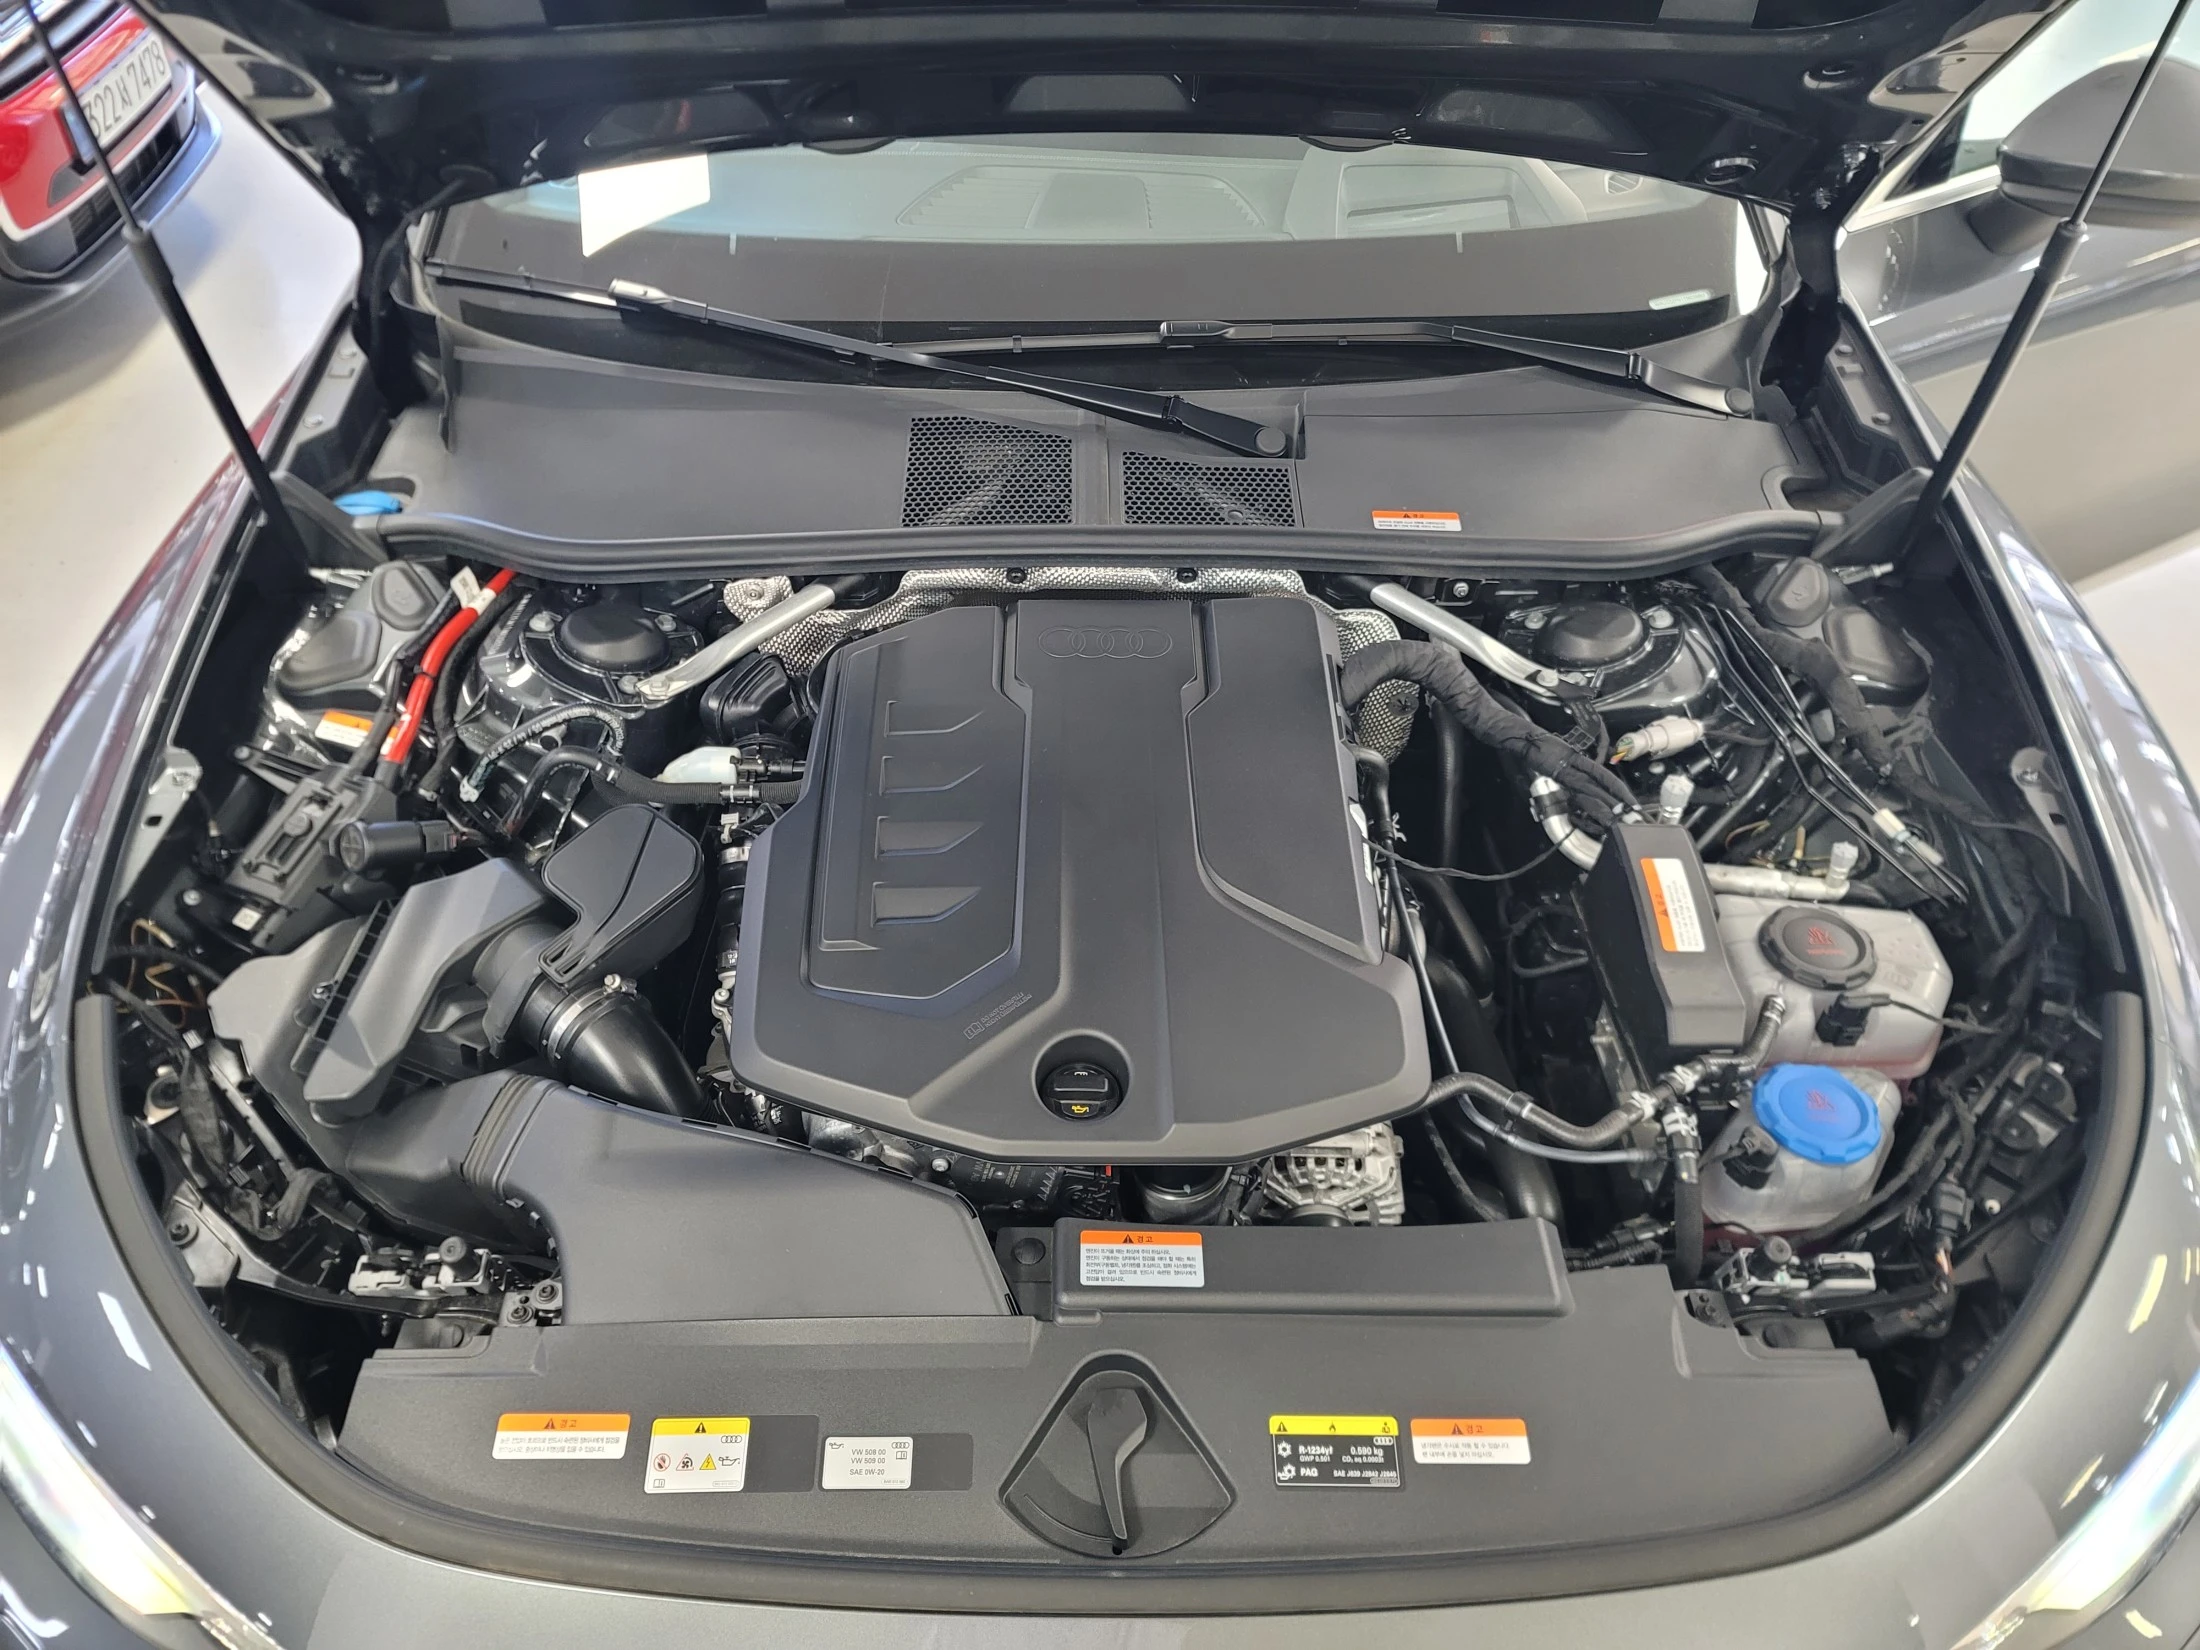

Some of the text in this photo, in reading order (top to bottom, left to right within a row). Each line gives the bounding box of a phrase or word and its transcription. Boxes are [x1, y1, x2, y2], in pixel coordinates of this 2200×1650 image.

[849, 1468, 885, 1476] SAE 0W-20
[1300, 1467, 1318, 1477] PAG
